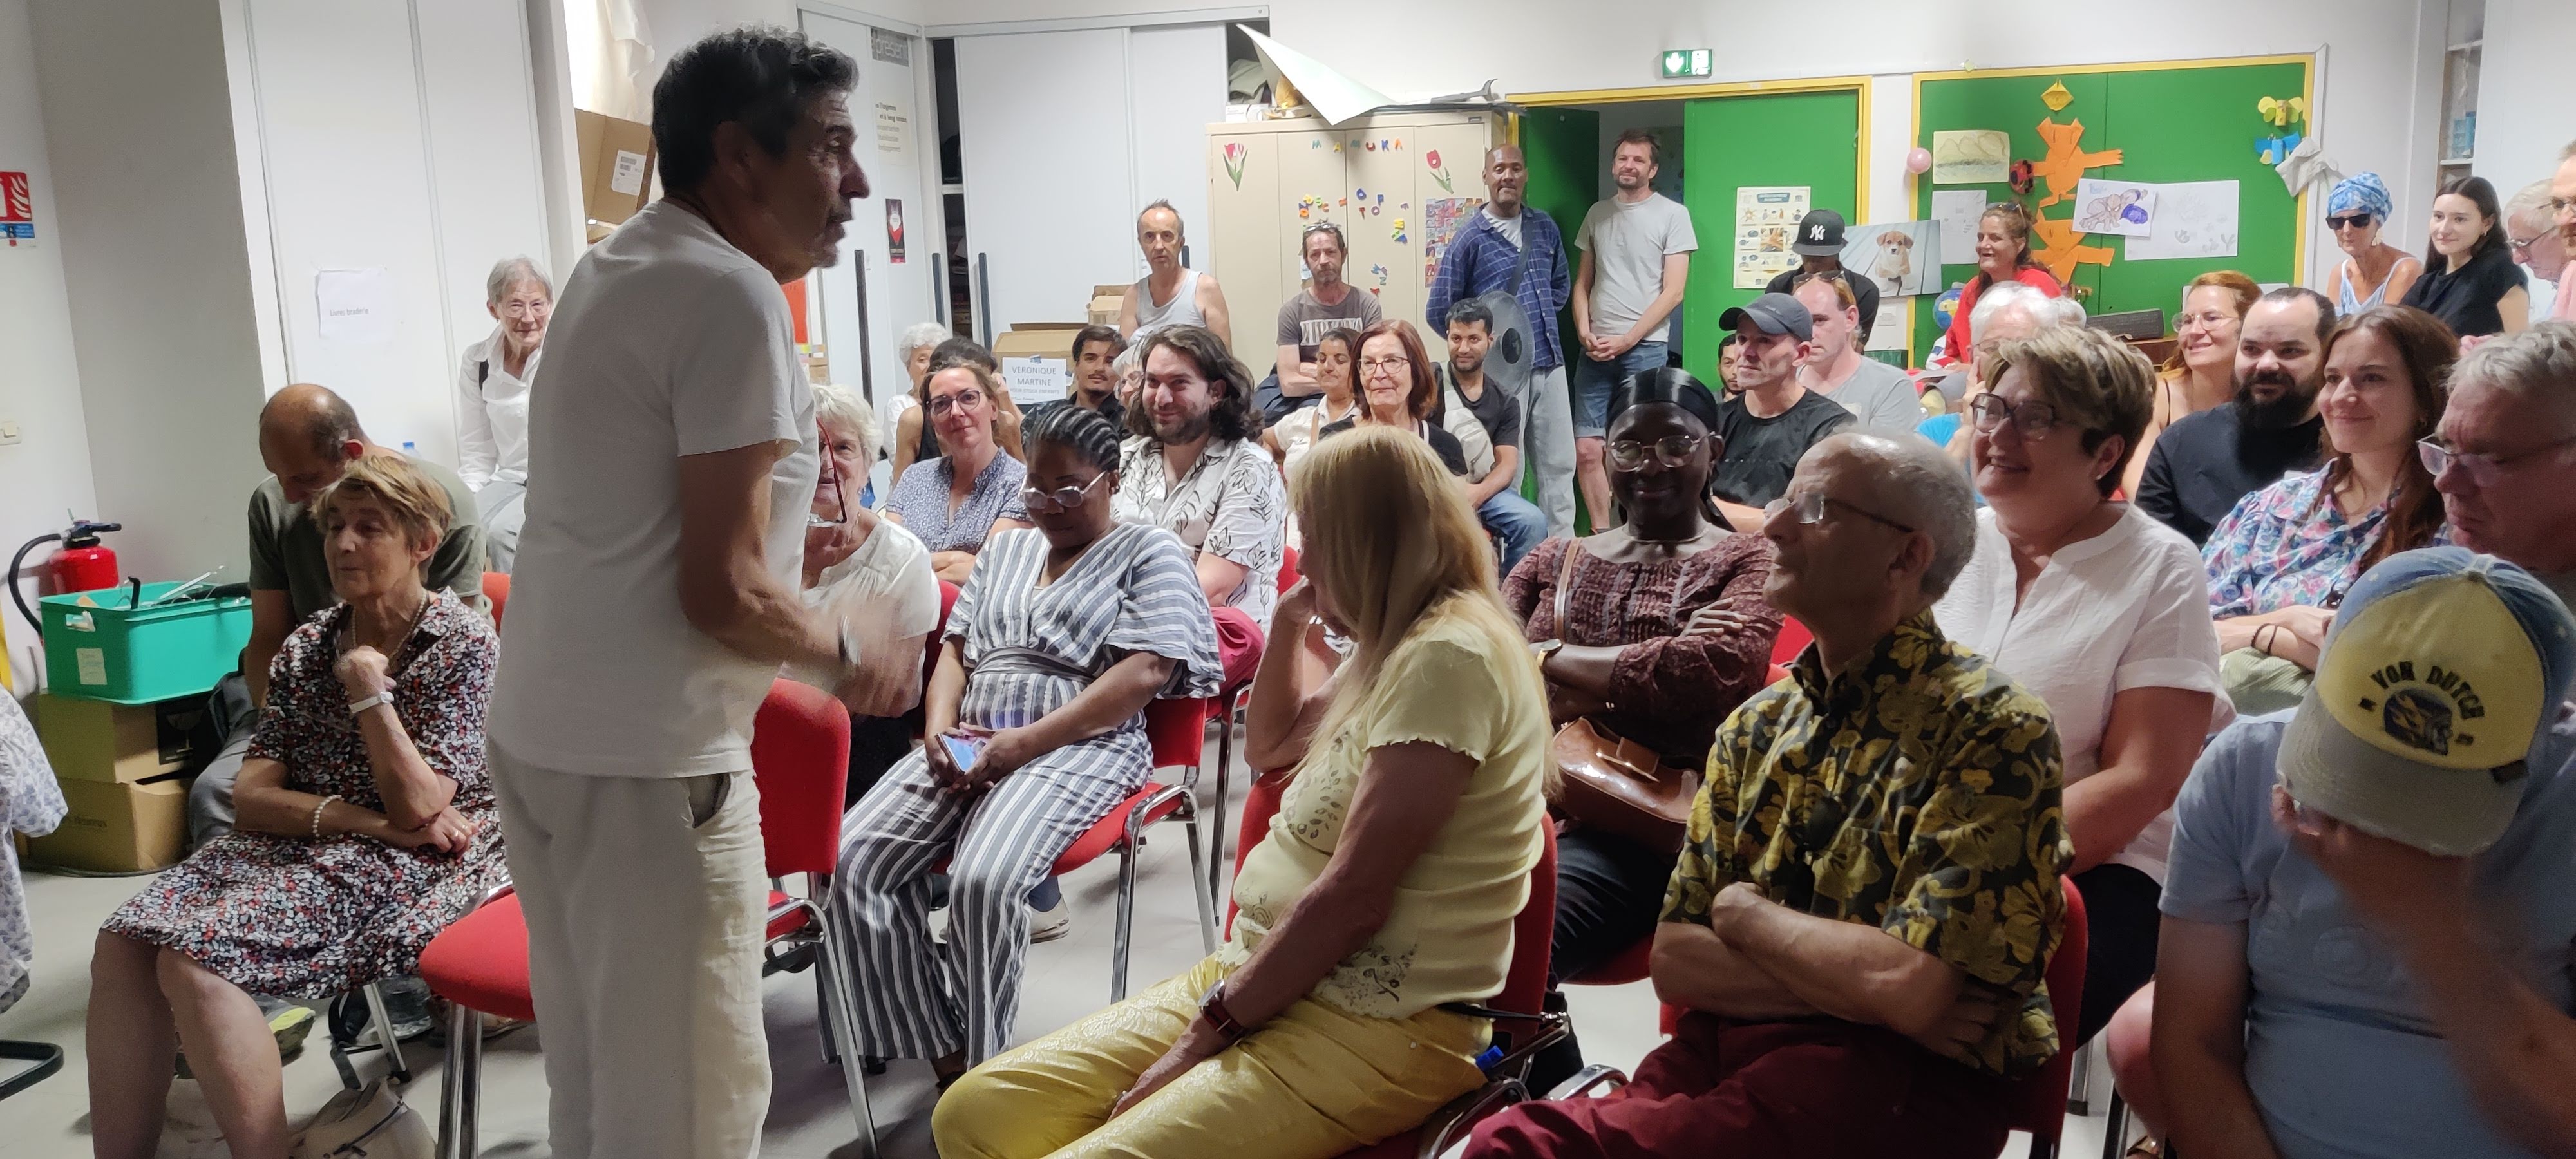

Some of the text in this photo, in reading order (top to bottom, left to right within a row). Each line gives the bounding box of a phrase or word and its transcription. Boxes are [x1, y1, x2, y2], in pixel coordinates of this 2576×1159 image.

[1012, 366, 1057, 375] VERONIQUE
[1017, 378, 1052, 386] MARTINE
[2426, 665, 2485, 719] DUTCH
